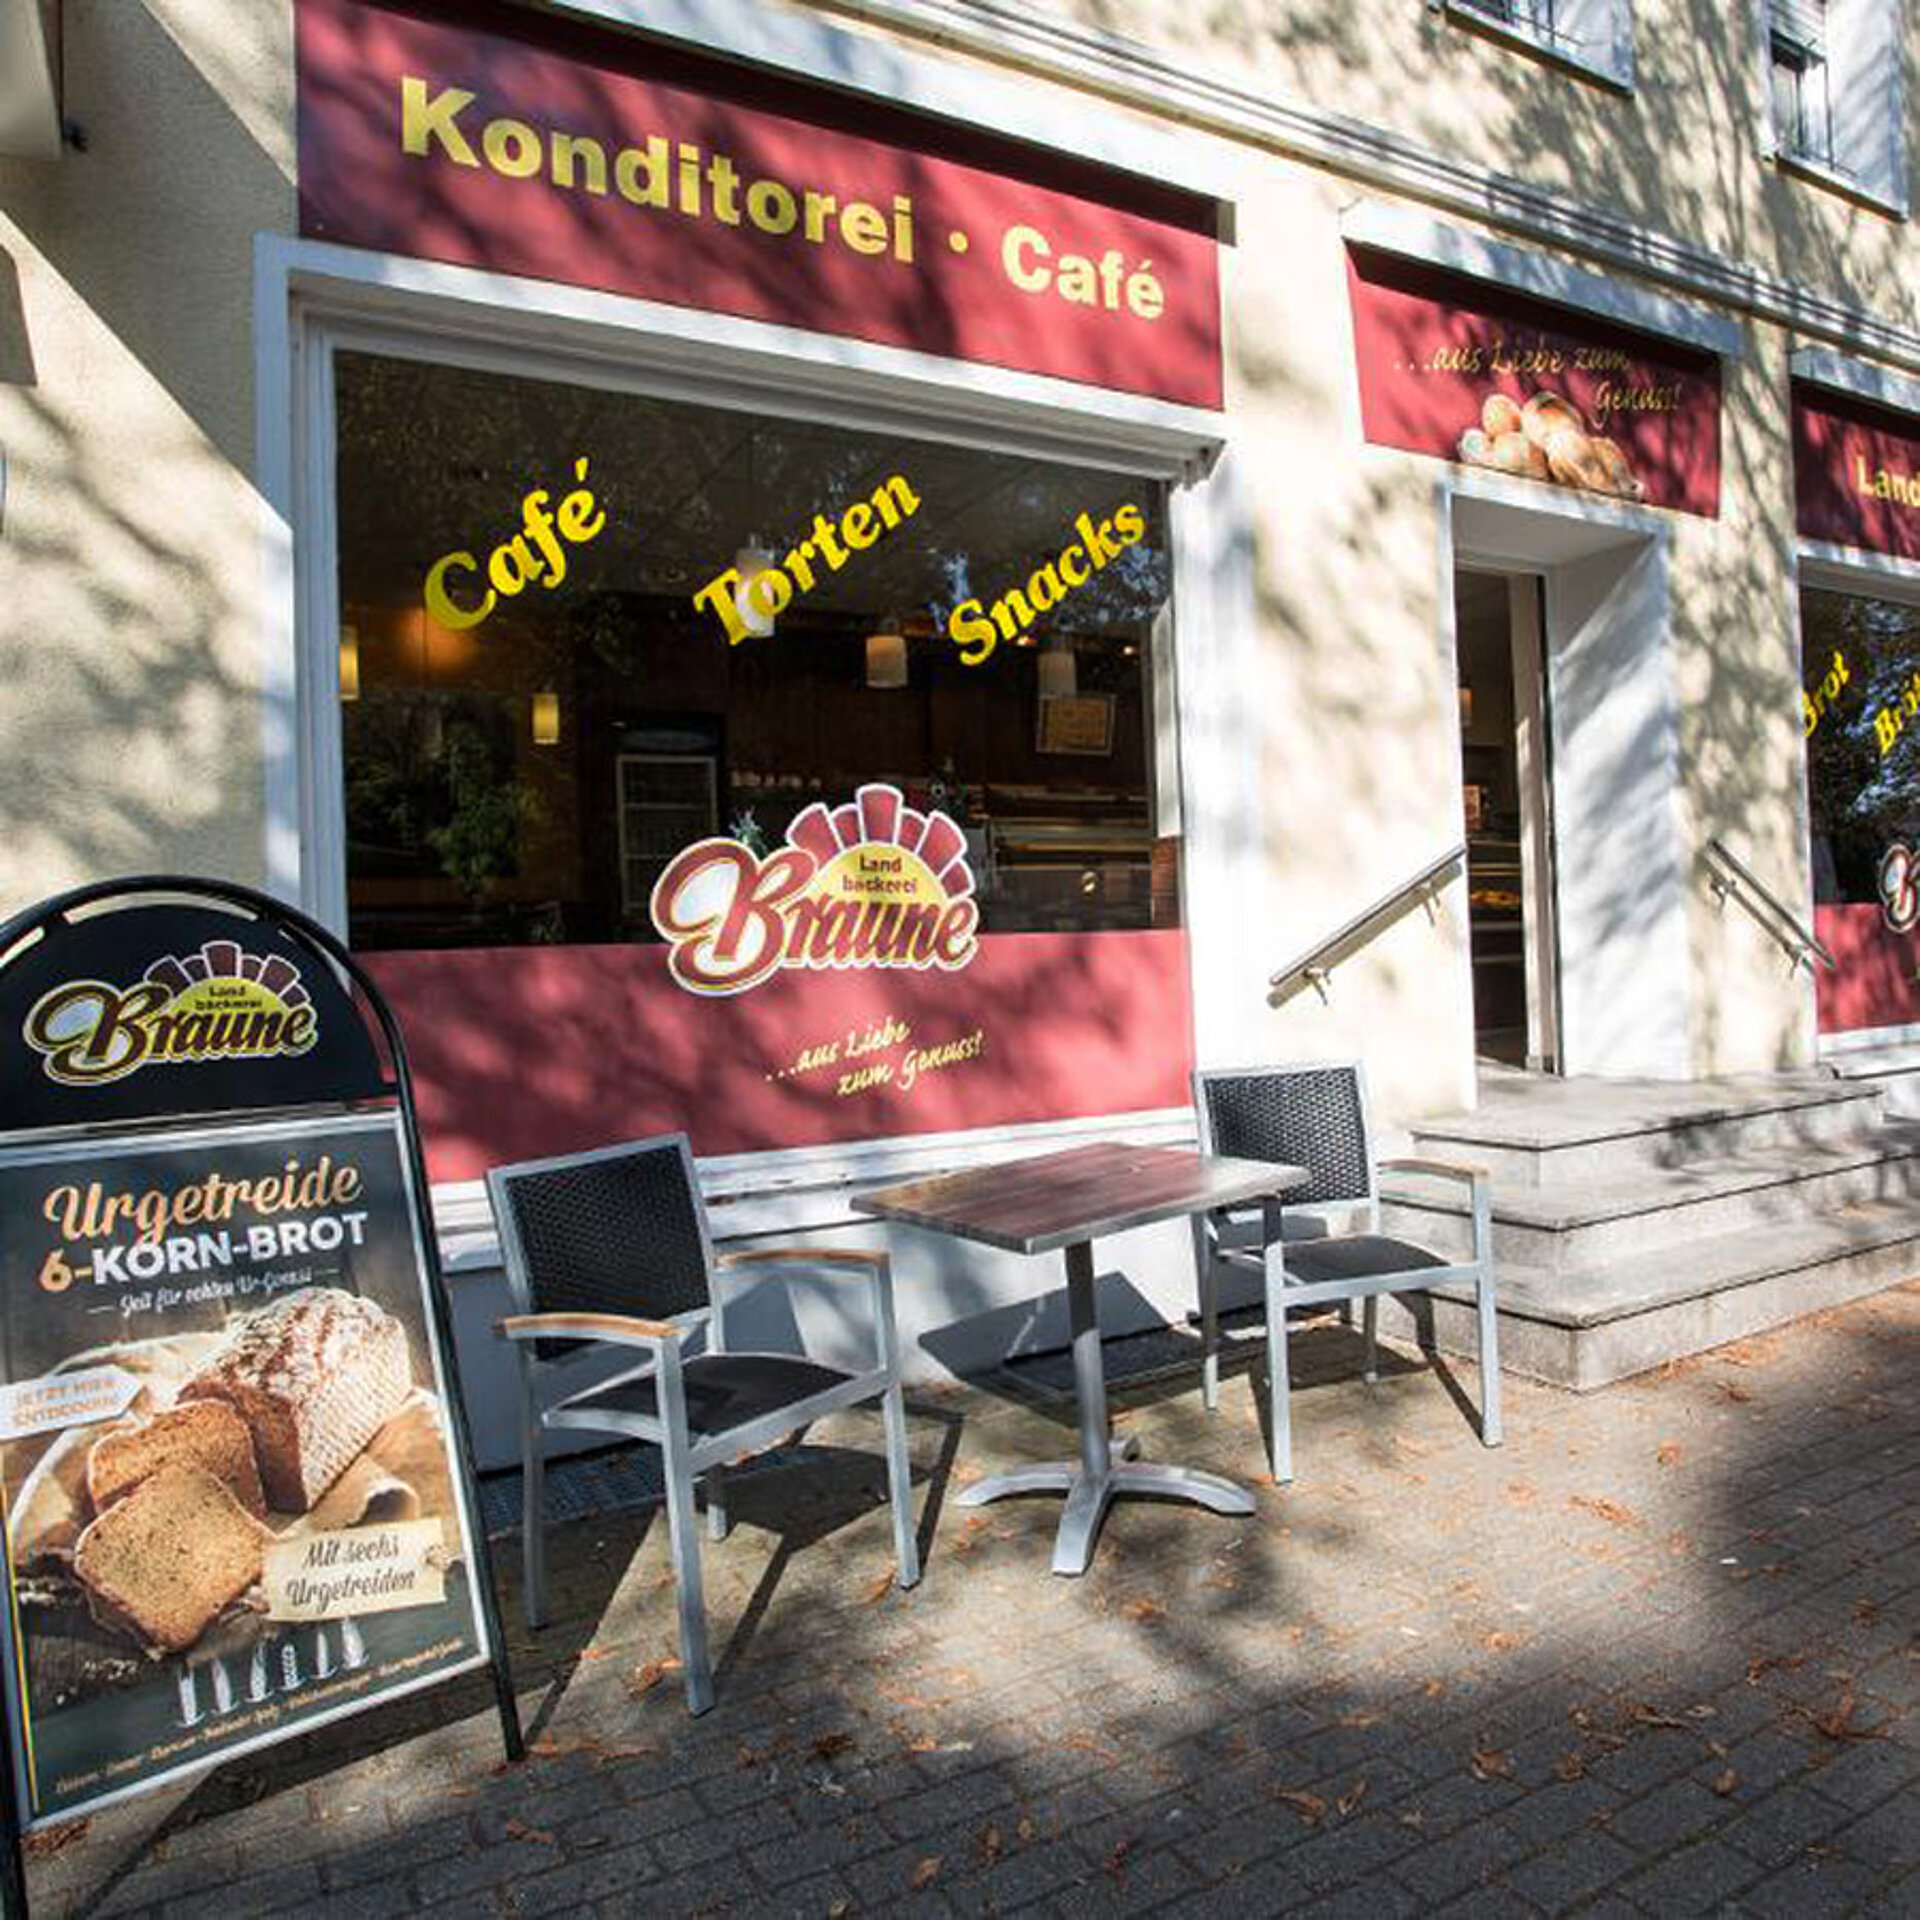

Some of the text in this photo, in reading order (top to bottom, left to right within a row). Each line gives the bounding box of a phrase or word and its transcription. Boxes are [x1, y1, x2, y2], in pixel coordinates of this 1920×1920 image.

[401, 76, 915, 264] Konditorei
[1002, 225, 1166, 322] Café
[1490, 334, 1566, 374] Liebe
[1573, 349, 1632, 372] zum
[1589, 379, 1682, 431] Genuss!
[424, 457, 1147, 667] Café Torten Snacks
[859, 854, 903, 873] Land
[651, 838, 979, 996] Braune
[24, 980, 318, 1085] Braune
[848, 1017, 909, 1056] Liebe
[836, 1061, 893, 1096] zum
[44, 1154, 364, 1246] Urgetreide
[40, 1212, 368, 1292] 6-KORN-BROT
[303, 1533, 400, 1569] Mit sechs
[285, 1568, 416, 1613] Urgetreiden
